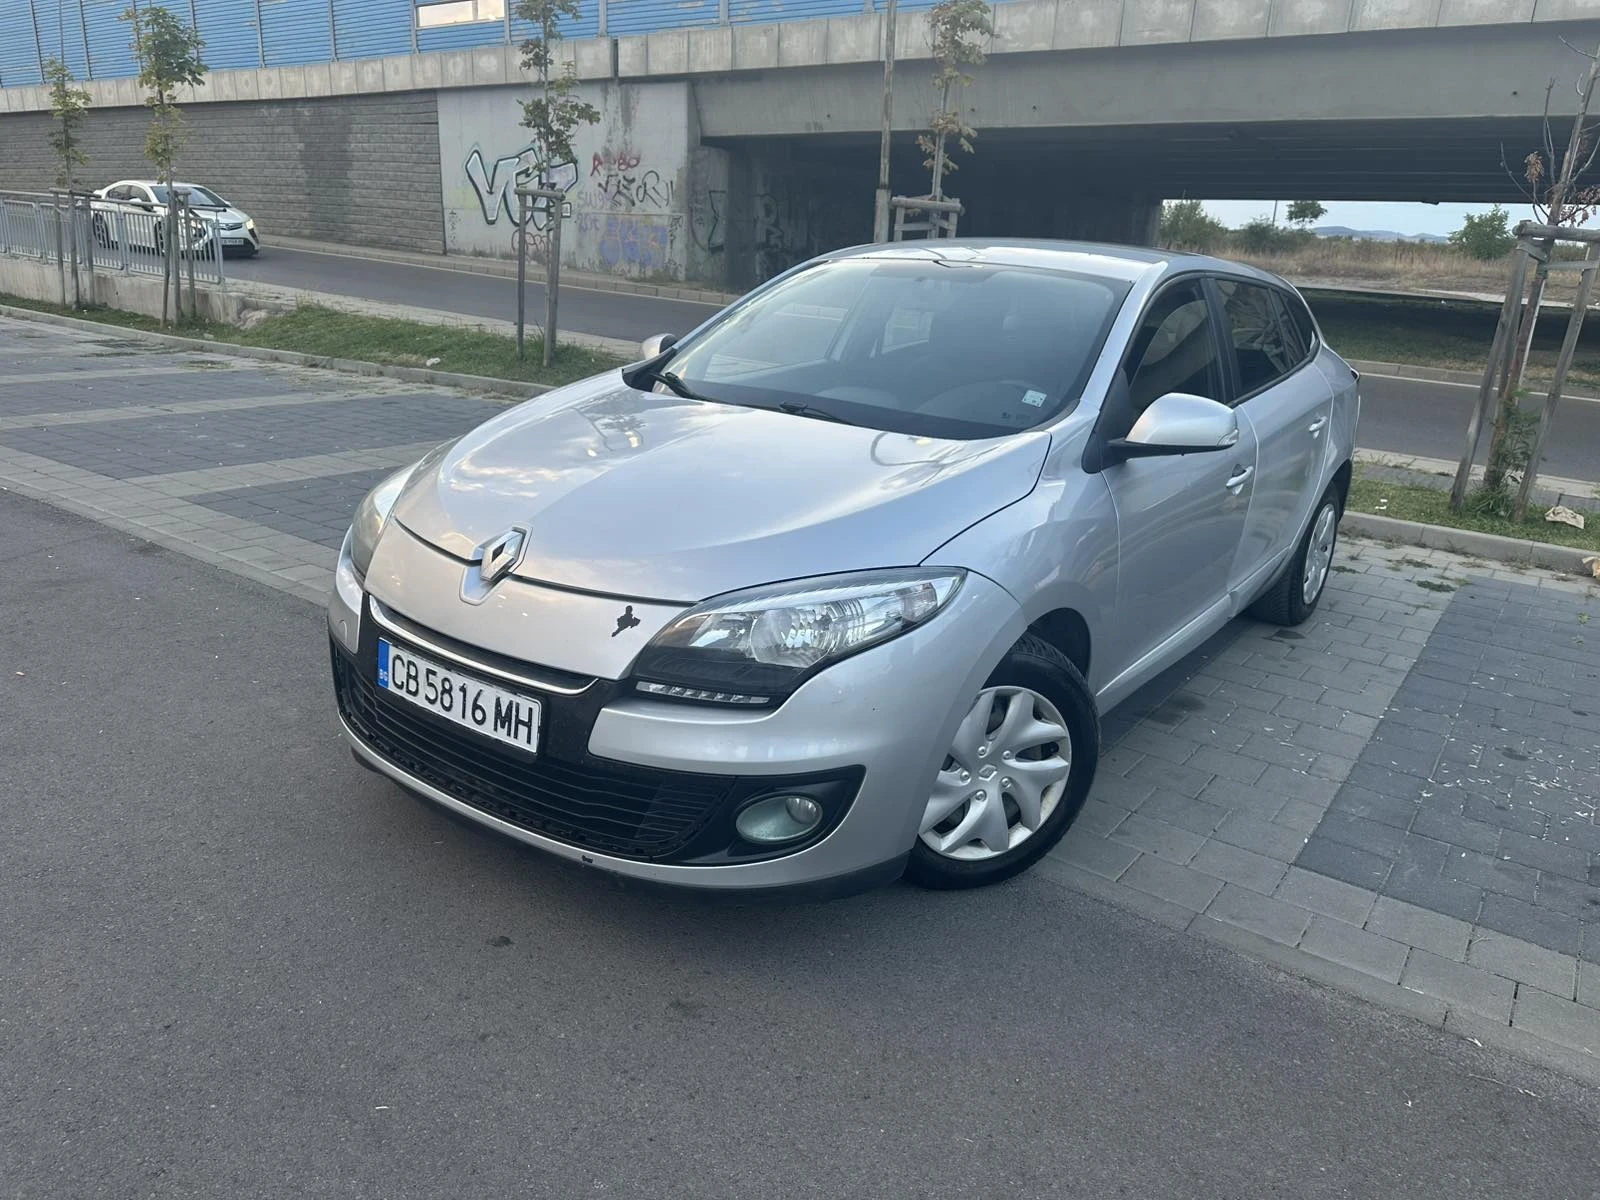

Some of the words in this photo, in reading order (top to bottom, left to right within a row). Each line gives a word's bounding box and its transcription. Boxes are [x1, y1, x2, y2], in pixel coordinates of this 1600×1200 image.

[392, 654, 419, 697] CB
[425, 668, 486, 725] 5816
[493, 696, 533, 744] MH
